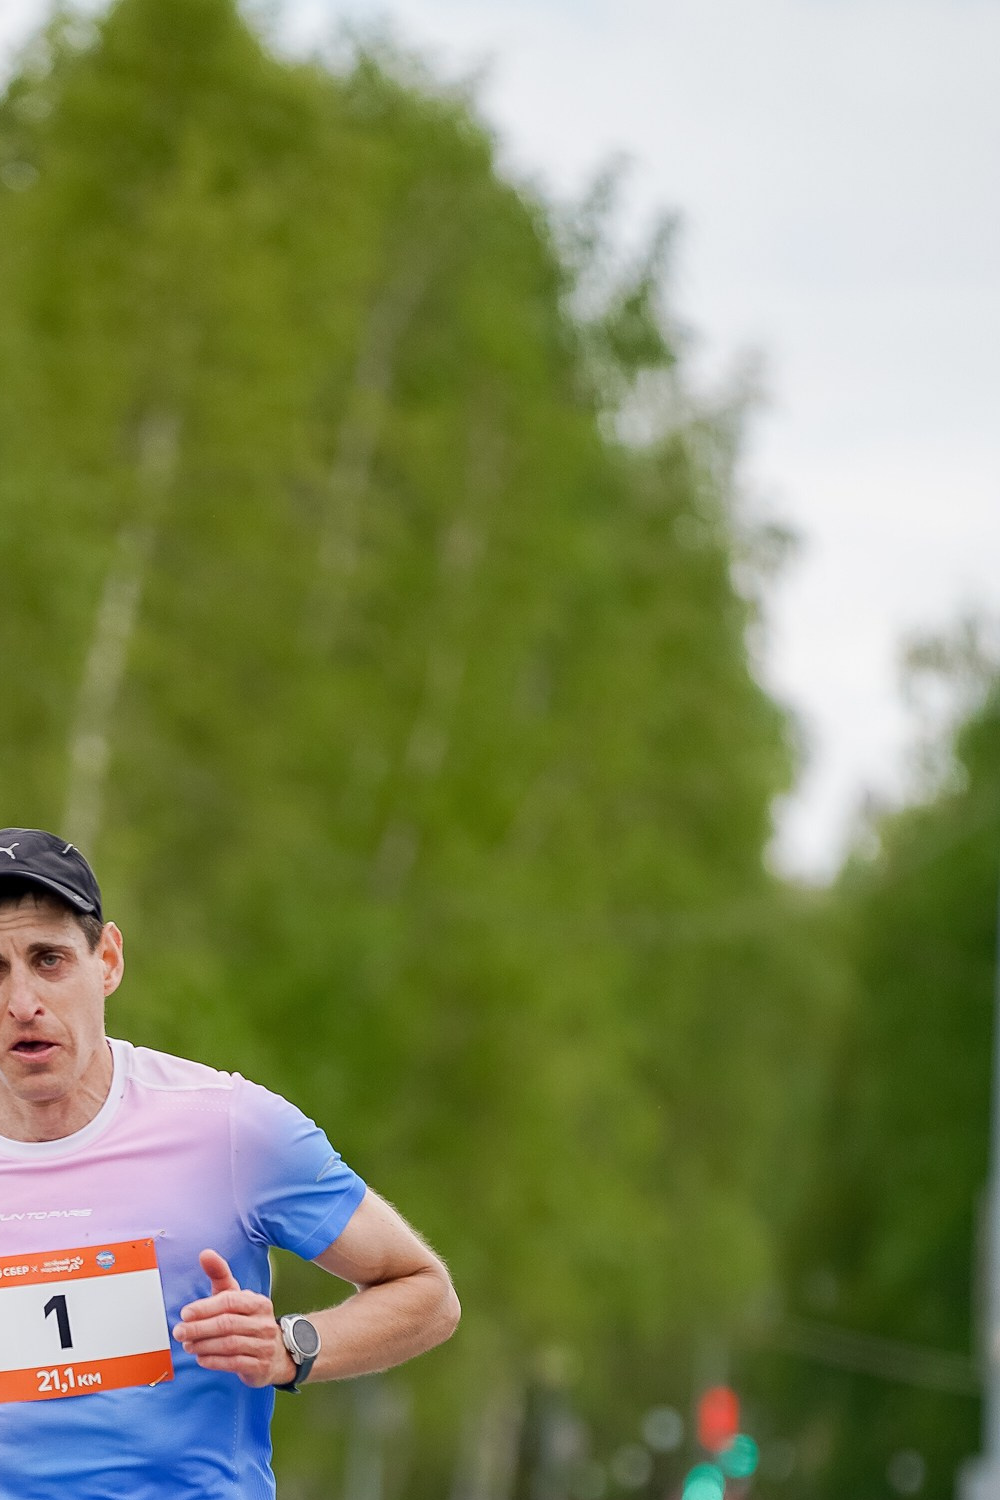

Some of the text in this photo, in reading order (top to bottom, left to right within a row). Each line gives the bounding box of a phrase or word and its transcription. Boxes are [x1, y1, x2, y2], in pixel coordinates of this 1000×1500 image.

[3, 1265, 30, 1277] СБЕР
[43, 1294, 73, 1350] 1
[36, 1367, 75, 1393] 21,1
